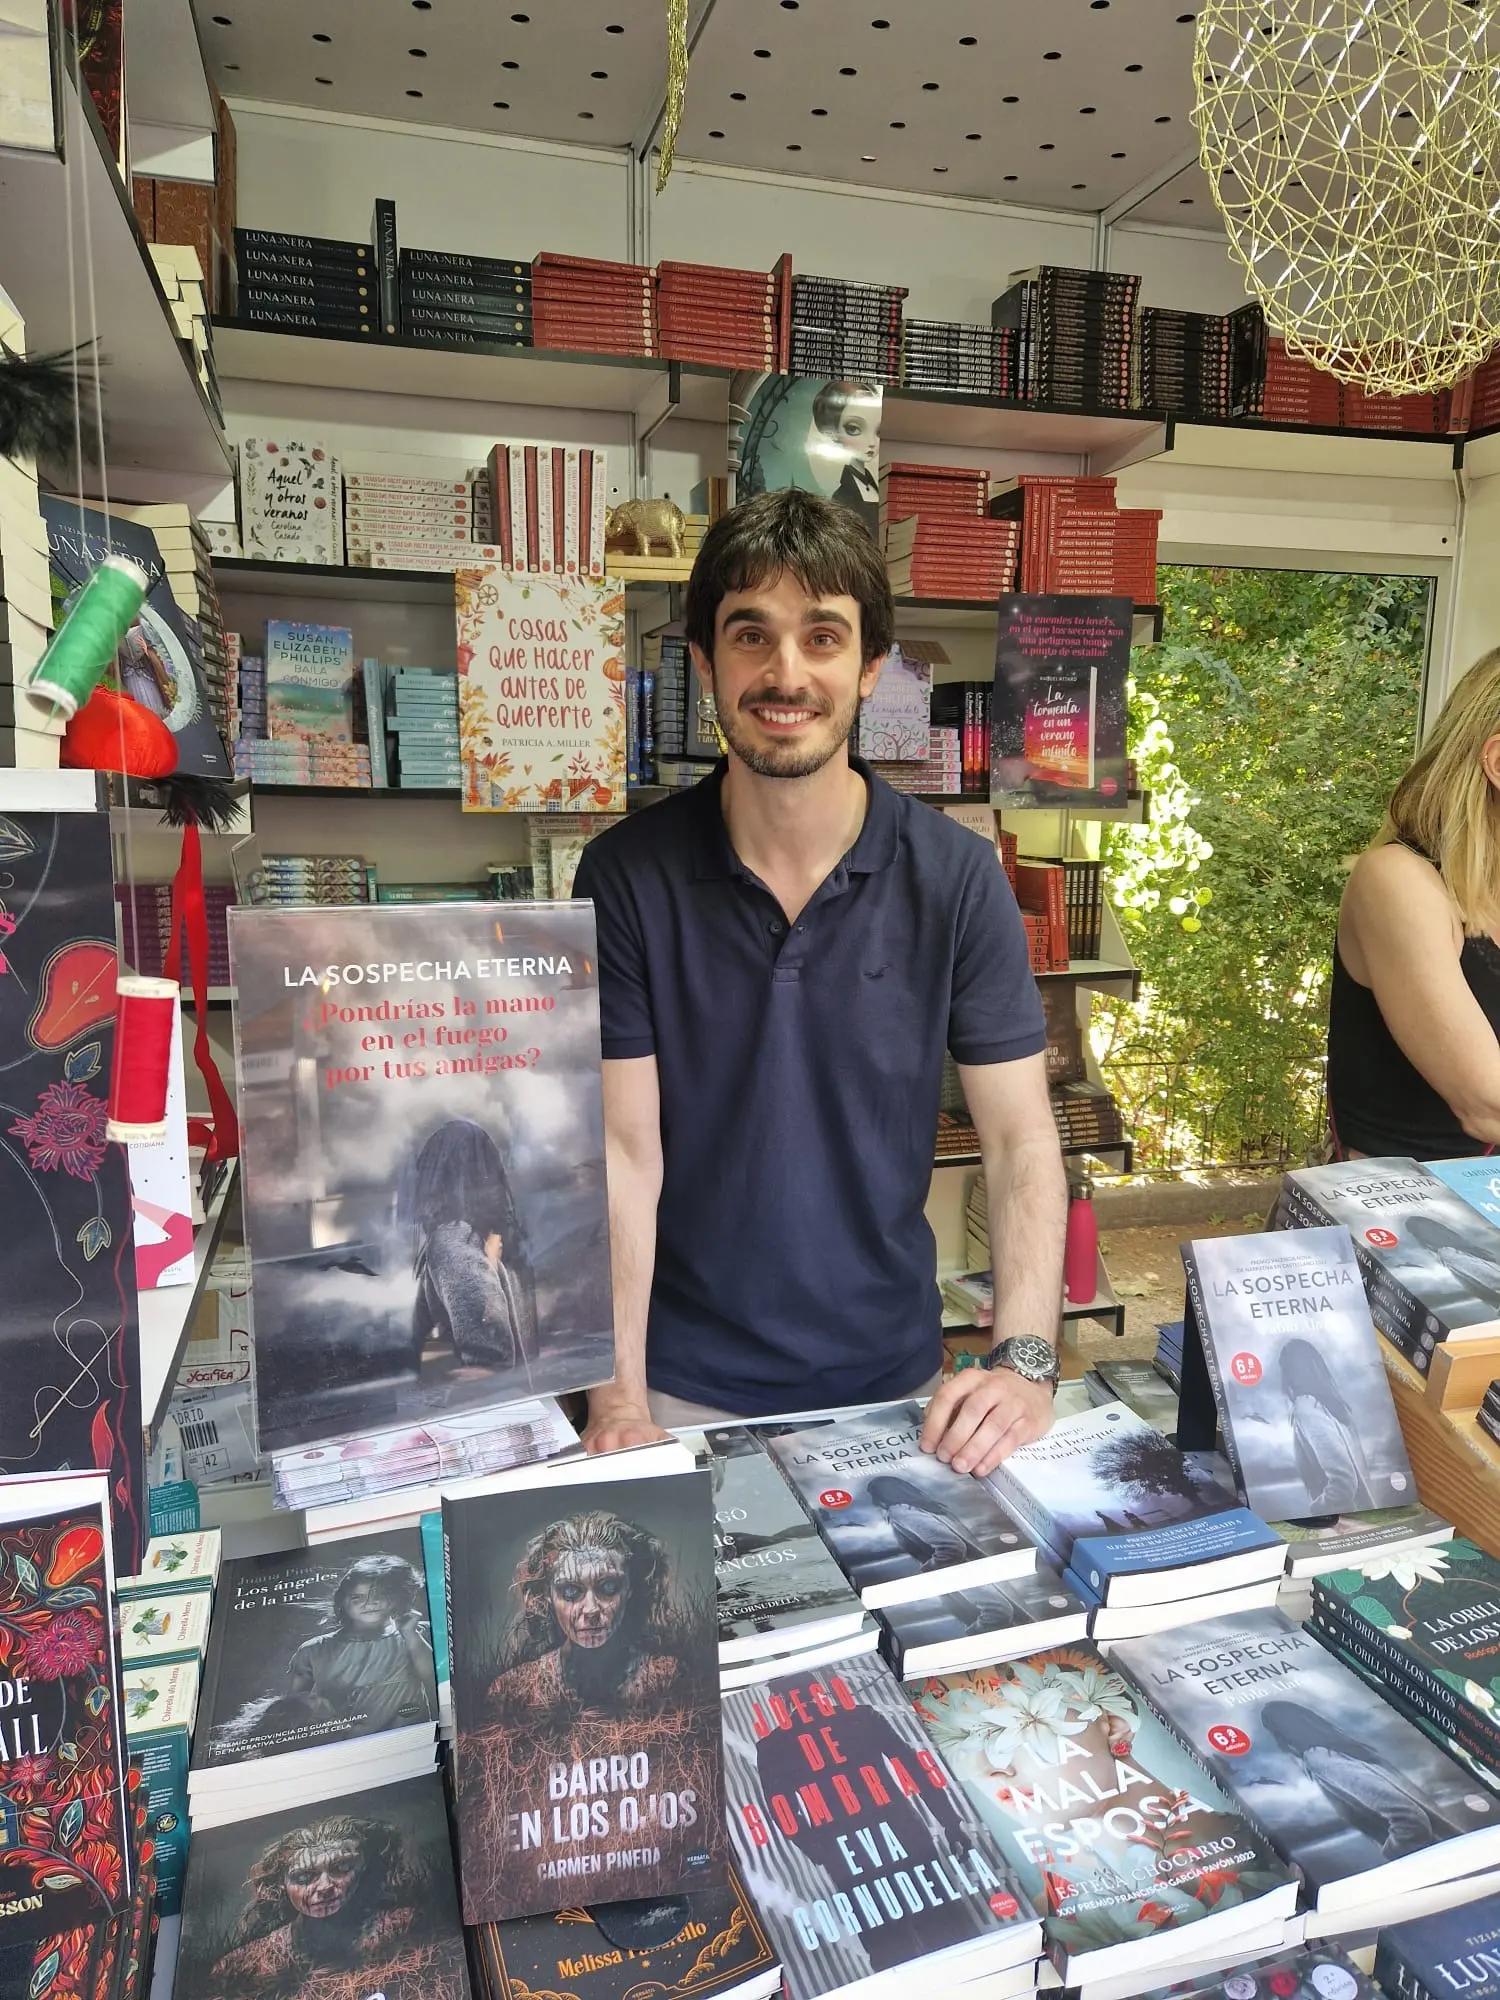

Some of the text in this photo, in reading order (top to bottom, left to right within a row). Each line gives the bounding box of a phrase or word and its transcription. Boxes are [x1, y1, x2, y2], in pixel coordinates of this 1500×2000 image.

[246, 232, 313, 249] LUNA NERA
[383, 212, 394, 280] LUNA NERA
[246, 250, 313, 268] LUNA NERA
[410, 251, 473, 268] LUNA NERA
[247, 269, 315, 288] LUNA NERA
[411, 270, 474, 287] LUNA NERA
[248, 290, 315, 307] LUNA NERA
[412, 289, 475, 306] LUNA NERA
[250, 309, 317, 327] LUNA NERA
[412, 308, 474, 325] LUNA NERA
[413, 327, 475, 344] LUNA NERA
[267, 467, 303, 489] Aquel
[265, 488, 306, 507] y otros
[263, 509, 308, 520] veranos
[273, 641, 348, 657] ELIZABETH
[287, 631, 334, 645] SUSAN
[280, 652, 342, 666] PHILLIPS
[294, 664, 327, 675] BAILA
[1047, 685, 1064, 704] La
[1033, 698, 1080, 717] tormenta
[1043, 719, 1055, 728] en
[502, 738, 544, 748] PATRICIA
[557, 739, 591, 748] MILLER
[1040, 731, 1075, 741] verano
[284, 956, 573, 987] LA SOSPECHA ETERNA
[453, 996, 476, 1016] la
[486, 994, 556, 1015] mano
[360, 1025, 508, 1052] en el fuego
[325, 1047, 542, 1091] por tus amigas?
[1292, 1187, 1301, 1199] LA
[1320, 1177, 1440, 1201] LA SOSPECHA
[1361, 1192, 1433, 1210] ETERNA
[1213, 1270, 1354, 1297] LA SOSPECHA
[1250, 1296, 1334, 1319] ETERNA
[1184, 1259, 1222, 1401] LA SOSPECHA ETERNA
[205, 1454, 218, 1466] 42
[793, 1455, 818, 1465] LA
[832, 1450, 912, 1472] ETERNA
[443, 1533, 451, 1580] BARRO
[234, 1586, 269, 1597] Los
[274, 1572, 338, 1590] ángeles
[234, 1592, 305, 1611] de la ira
[733, 1596, 800, 1616] CORNUDELLA
[1422, 1618, 1454, 1634] LA
[1430, 1636, 1464, 1654] DE
[1457, 1624, 1499, 1646] LOS
[1151, 1637, 1310, 1685] LA SOSPECHA
[1341, 1608, 1355, 1625] LA
[1354, 1618, 1390, 1654] ORILLA
[1389, 1647, 1403, 1665] DE
[1404, 1661, 1424, 1684] LOS
[1425, 1677, 1457, 1709] VIVOS
[1203, 1660, 1300, 1695] ETERNA
[1341, 1631, 1354, 1649] LA
[1354, 1641, 1389, 1679] ORILLA
[1389, 1672, 1403, 1691] DE
[1404, 1686, 1425, 1710] LOS
[1425, 1702, 1457, 1735] VIVOS
[0, 1676, 32, 1707] DE
[752, 1676, 856, 1738] JUEGO
[216, 1738, 249, 1750] PREMIO
[250, 1729, 296, 1742] PROVINCIA
[309, 1713, 368, 1730] GUADALAJARA
[228, 1740, 275, 1754] NARRATIVA
[276, 1732, 308, 1744] CAMILO
[309, 1727, 330, 1737] JOSÉ
[331, 1724, 352, 1733] CELA
[798, 1726, 848, 1772] DE
[549, 1751, 650, 1800] BARRO
[1009, 1758, 1153, 1815] MALA
[742, 1749, 948, 1848] SOMBRAS
[509, 1789, 697, 1851] EN LOS OJOS
[1013, 1786, 1215, 1864] ESPOSA
[837, 1821, 908, 1876] EVA
[537, 1847, 661, 1880] CARMEN PINEDA
[1055, 1836, 1236, 1900] ESTELA CHOCARRO
[1056, 1850, 1256, 1917] XXV PREMIO FRANCISCO GARCÍA PAVÓN 2023
[792, 1848, 1000, 1952] CORNUDELLA
[556, 1953, 624, 1979] Melissa
